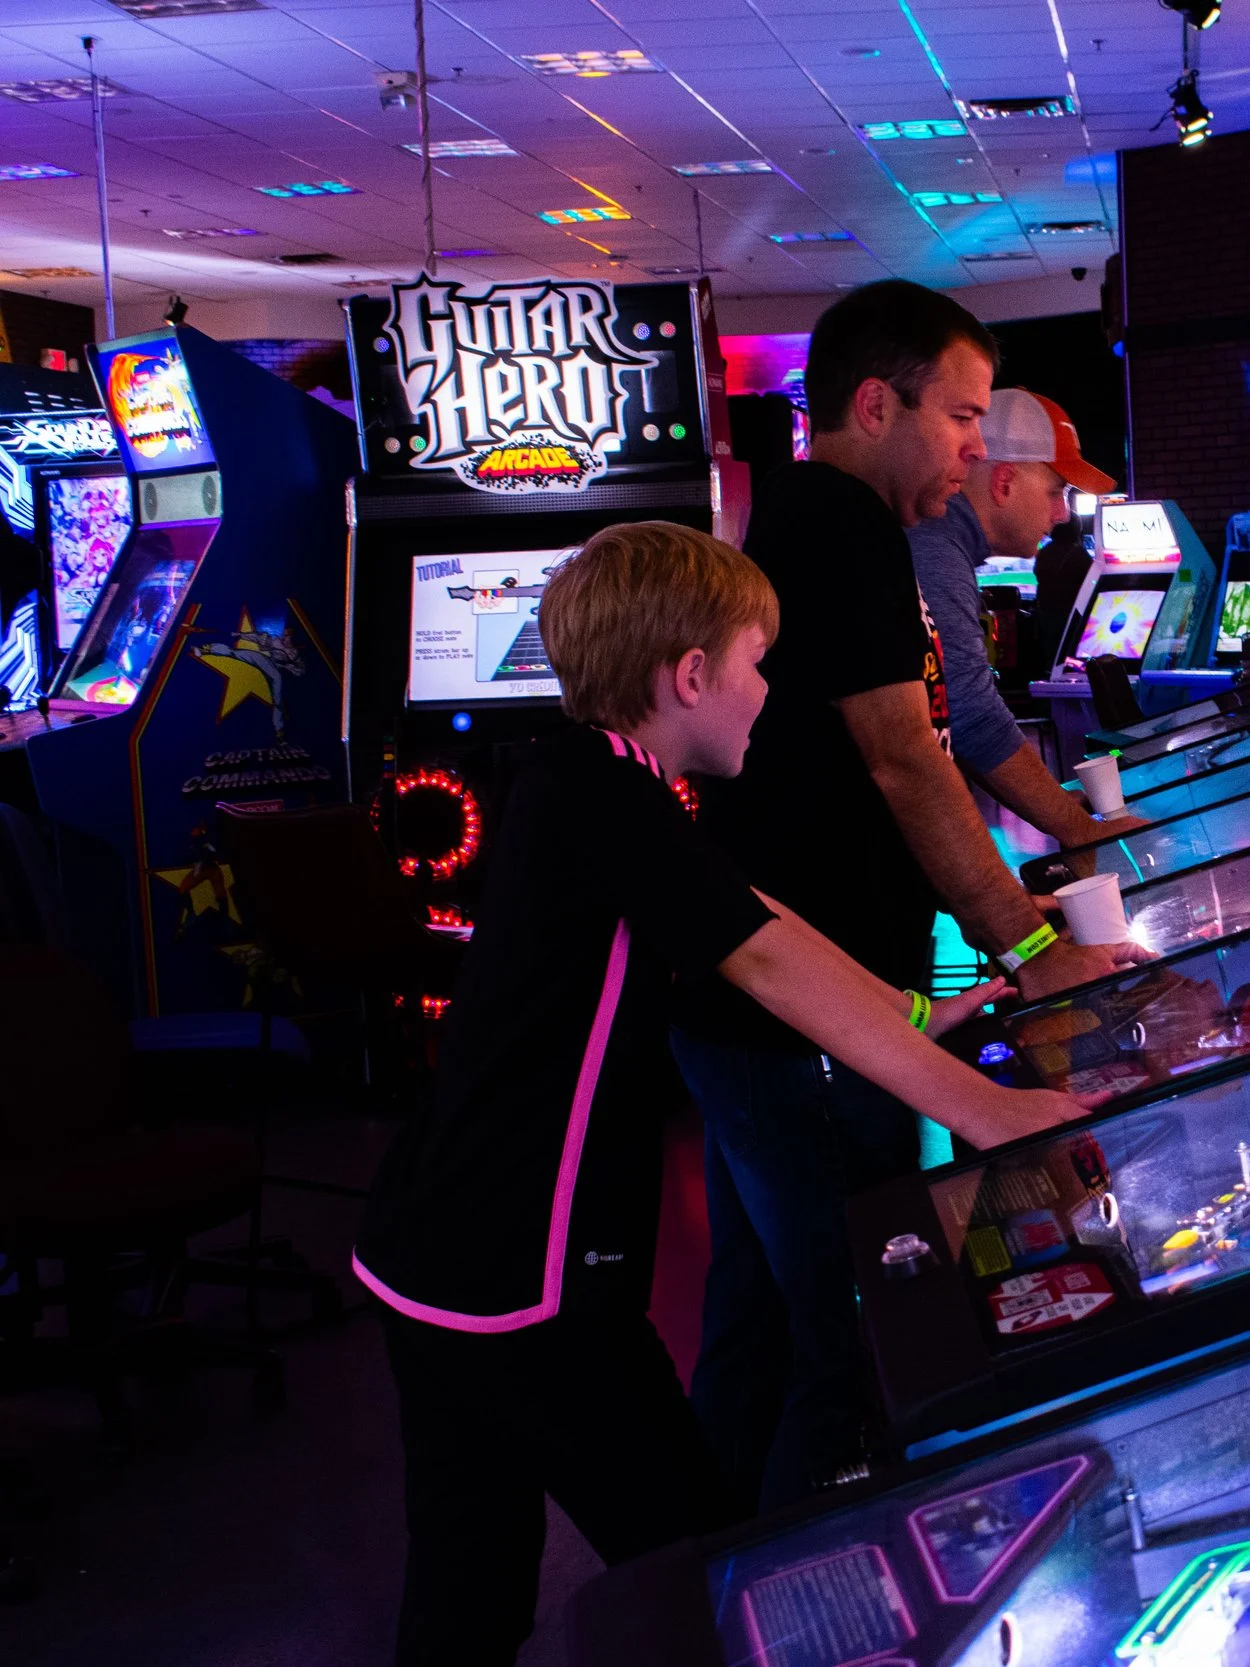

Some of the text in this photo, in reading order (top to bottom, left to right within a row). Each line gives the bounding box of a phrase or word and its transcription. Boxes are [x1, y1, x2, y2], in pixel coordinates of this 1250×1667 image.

[478, 447, 581, 477] ARCADE
[416, 558, 464, 582] TUTORIAL
[204, 744, 310, 767] CAPTAIN
[182, 765, 332, 793] COMMANDO
